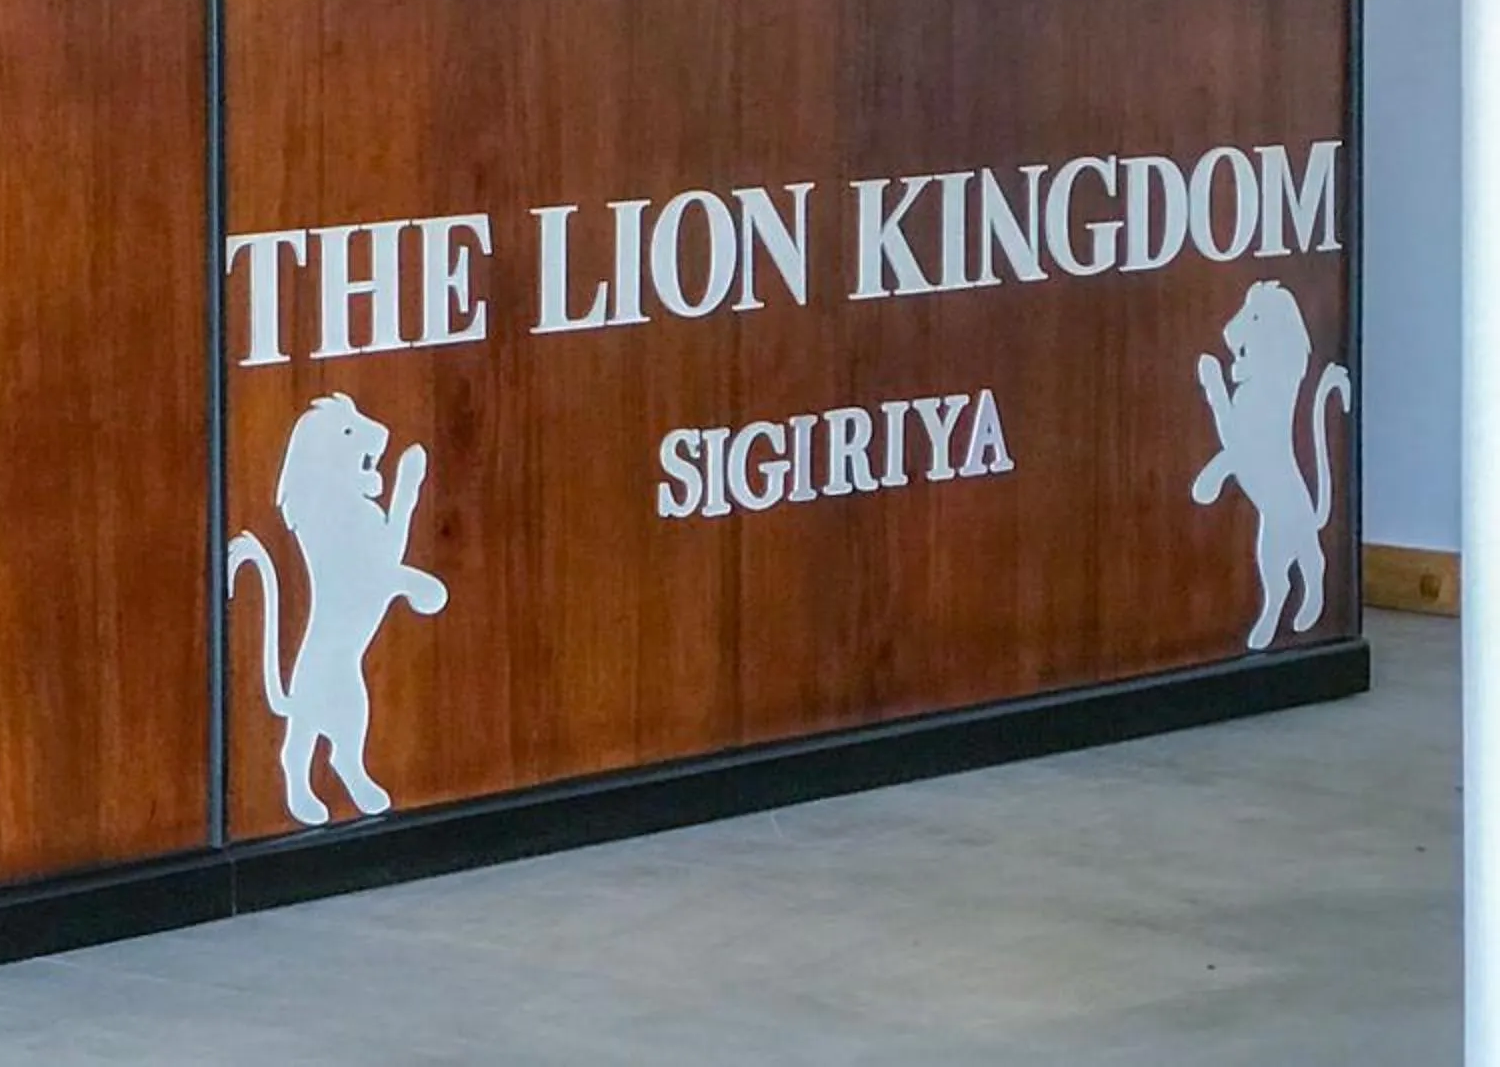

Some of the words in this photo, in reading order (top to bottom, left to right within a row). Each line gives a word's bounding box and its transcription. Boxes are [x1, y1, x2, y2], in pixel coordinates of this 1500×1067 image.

[226, 213, 492, 367] THE
[530, 182, 815, 334] LION
[848, 140, 1343, 300] KINGDOM
[657, 389, 1015, 518] SIGIRIYA
